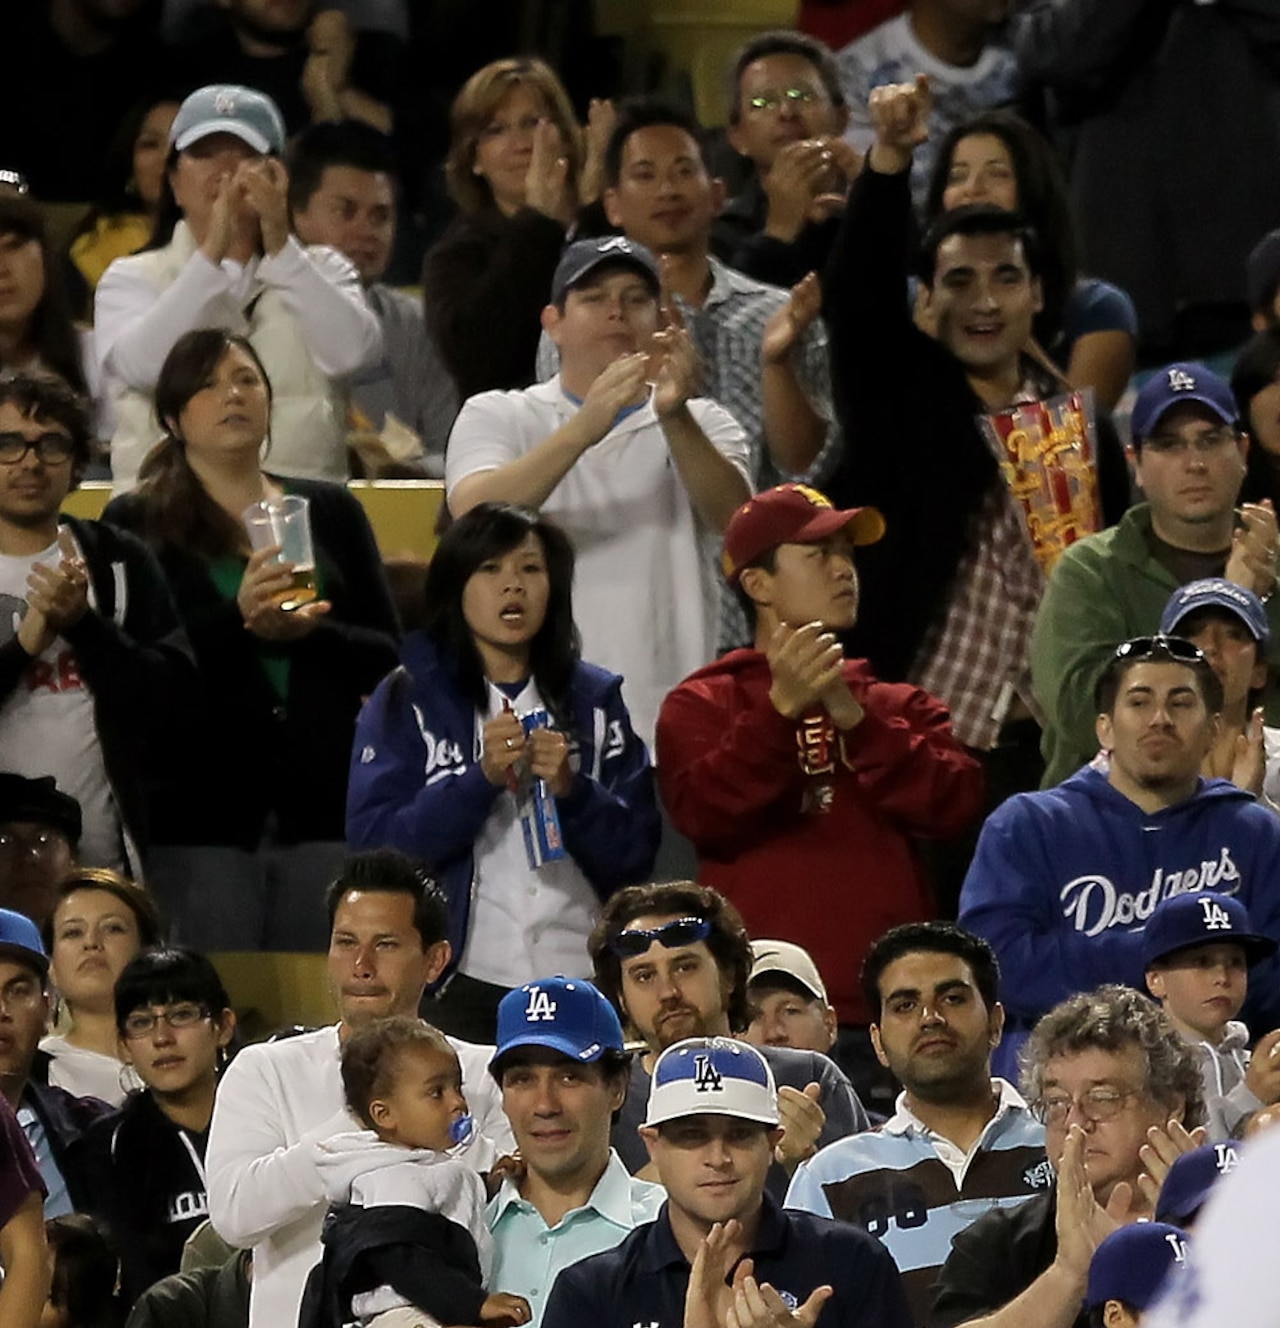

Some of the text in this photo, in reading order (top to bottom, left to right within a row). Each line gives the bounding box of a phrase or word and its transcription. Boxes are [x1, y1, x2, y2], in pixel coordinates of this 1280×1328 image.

[1167, 368, 1195, 391] LA
[1196, 897, 1234, 931] LA
[522, 985, 557, 1022] LA
[694, 1055, 723, 1092] LA
